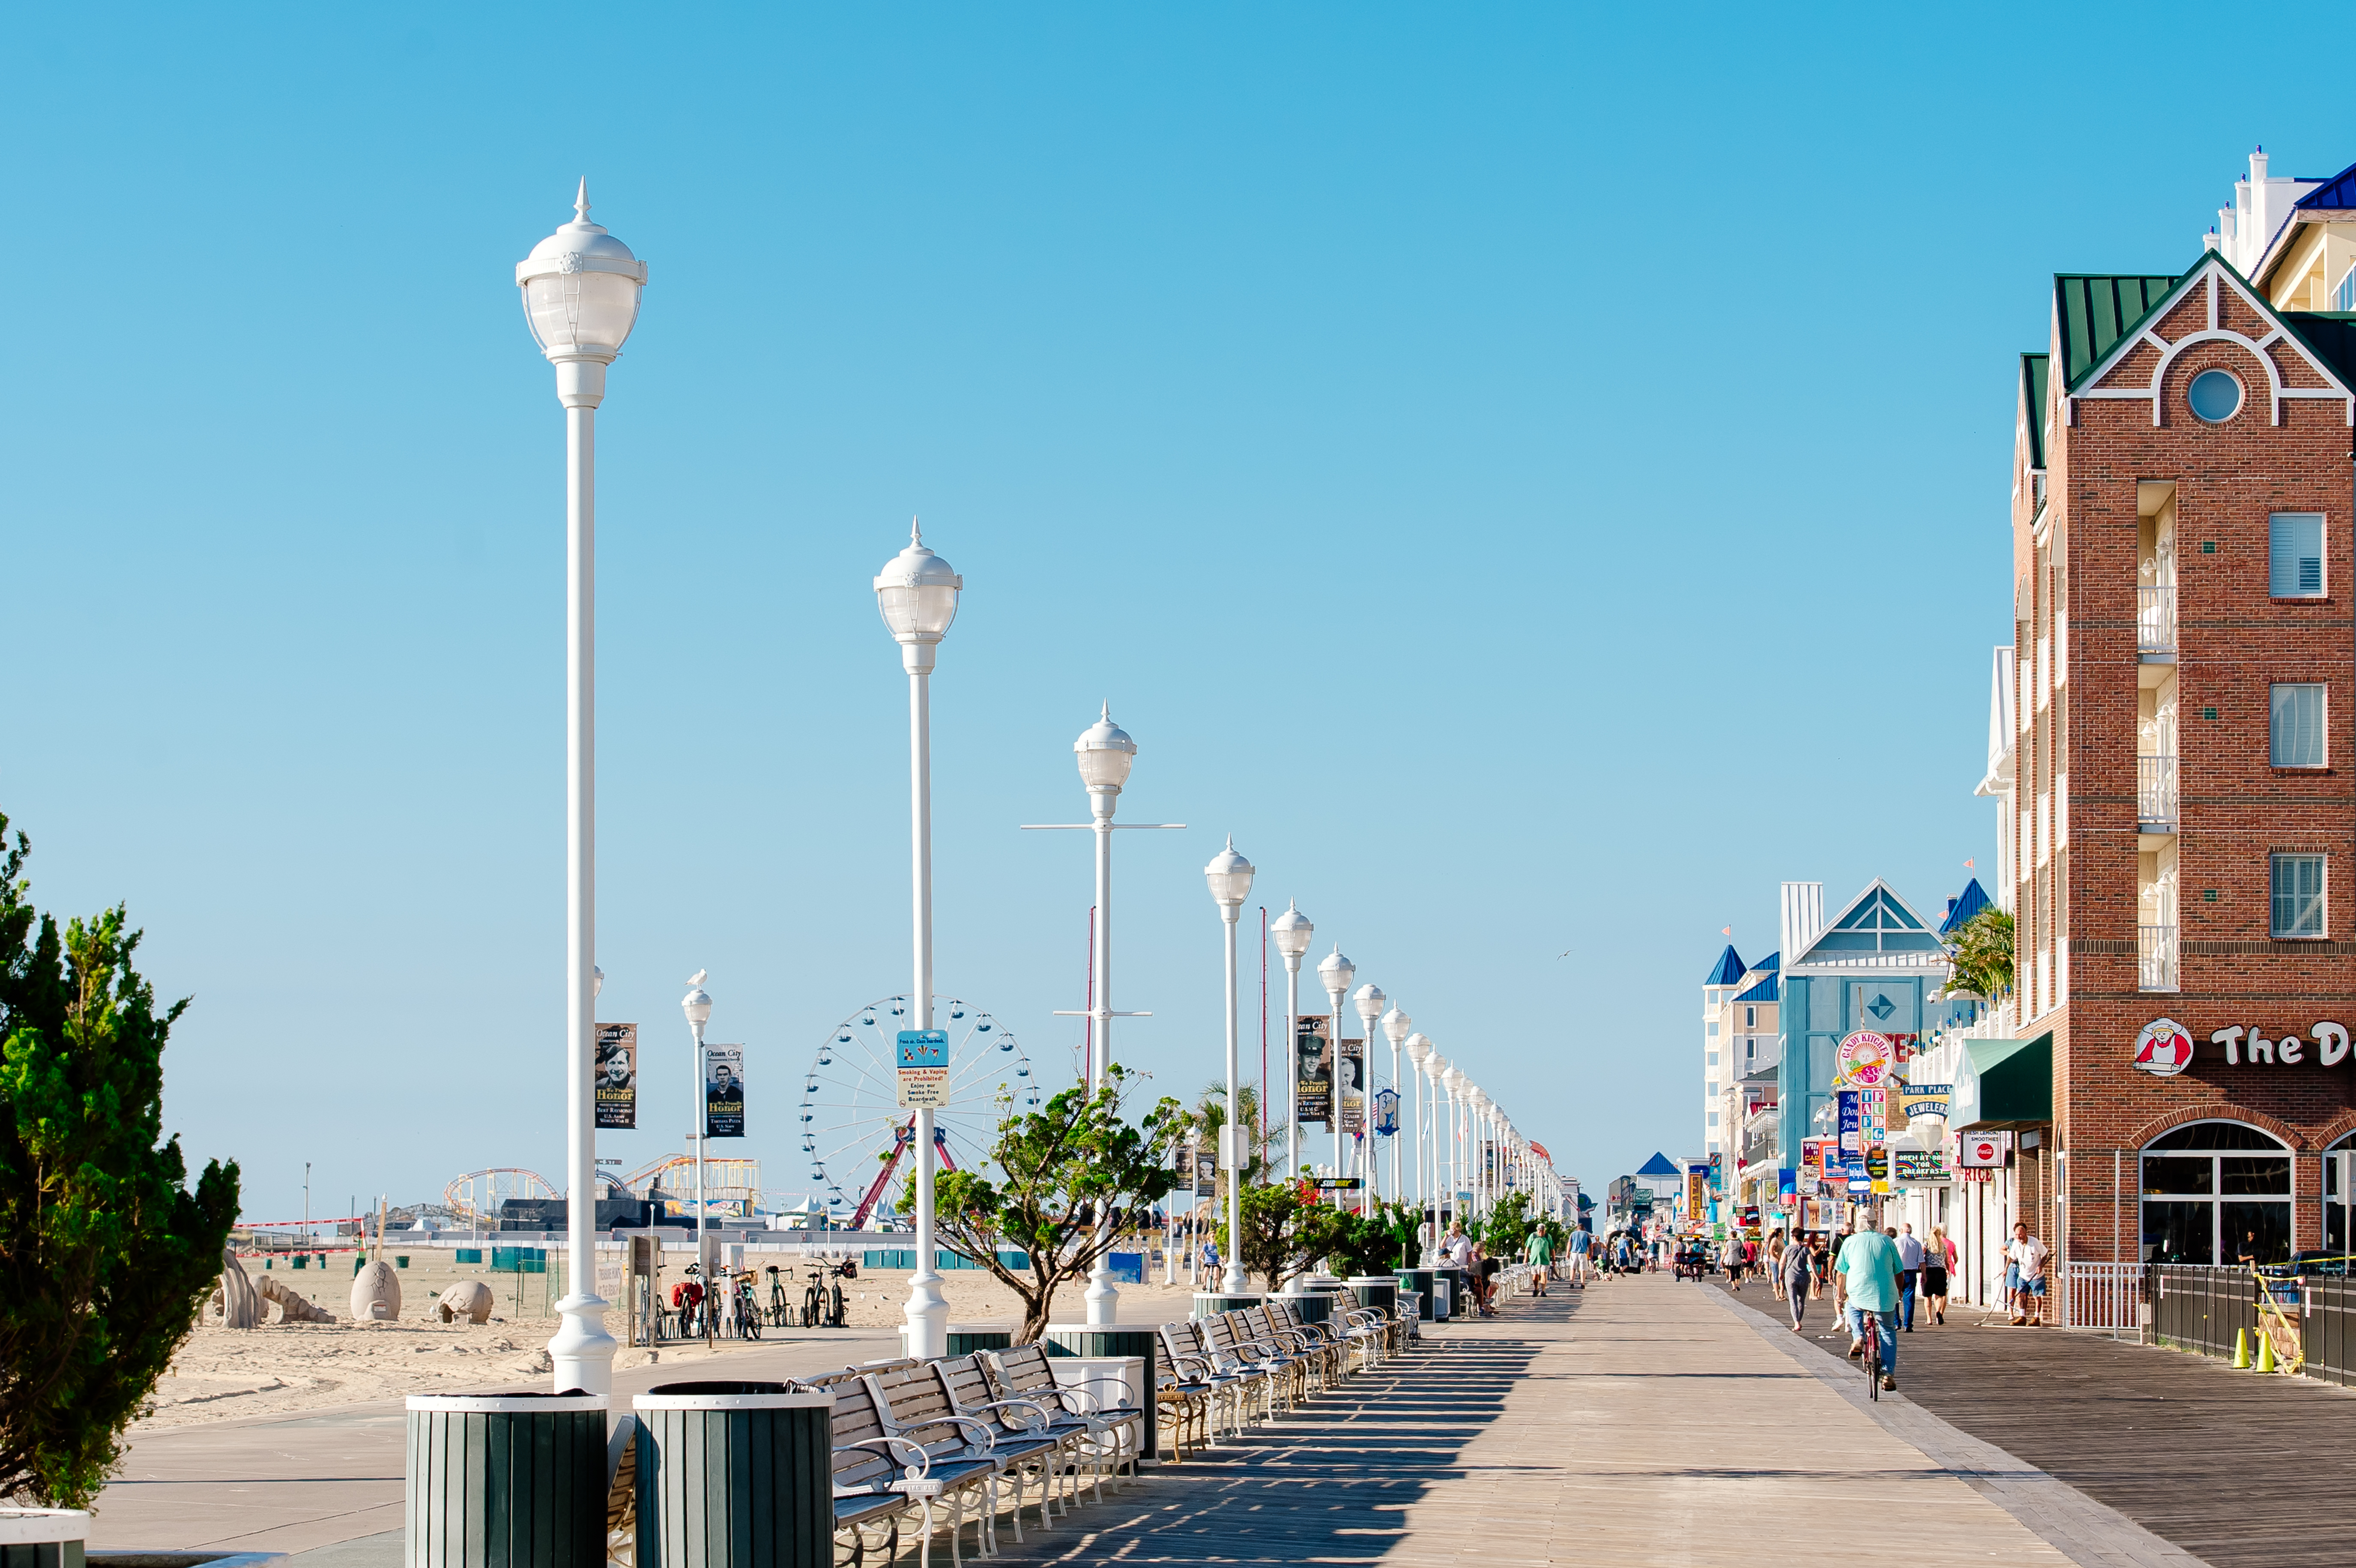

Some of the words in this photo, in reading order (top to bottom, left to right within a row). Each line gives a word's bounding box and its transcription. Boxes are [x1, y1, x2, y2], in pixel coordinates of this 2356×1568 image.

[1312, 1021, 1328, 1032] City
[596, 1029, 617, 1037] Ocean
[619, 1029, 634, 1039] City
[1348, 1044, 1362, 1054] City
[1842, 1035, 1860, 1058] CANDY
[1862, 1034, 1890, 1058] KITCHEN
[2211, 1024, 2304, 1066] The
[2309, 1020, 2356, 1067] D
[728, 1049, 741, 1060] City
[597, 1089, 634, 1100] Honor
[1905, 1086, 1925, 1094] PARK
[1928, 1085, 1951, 1094] PLACE
[709, 1102, 742, 1111] Honor
[1382, 1095, 1393, 1109] 3rd
[1909, 1102, 1948, 1116] JEWELERS
[1862, 1091, 1872, 1152] TAFFY
[1964, 1168, 1992, 1182] RICE
